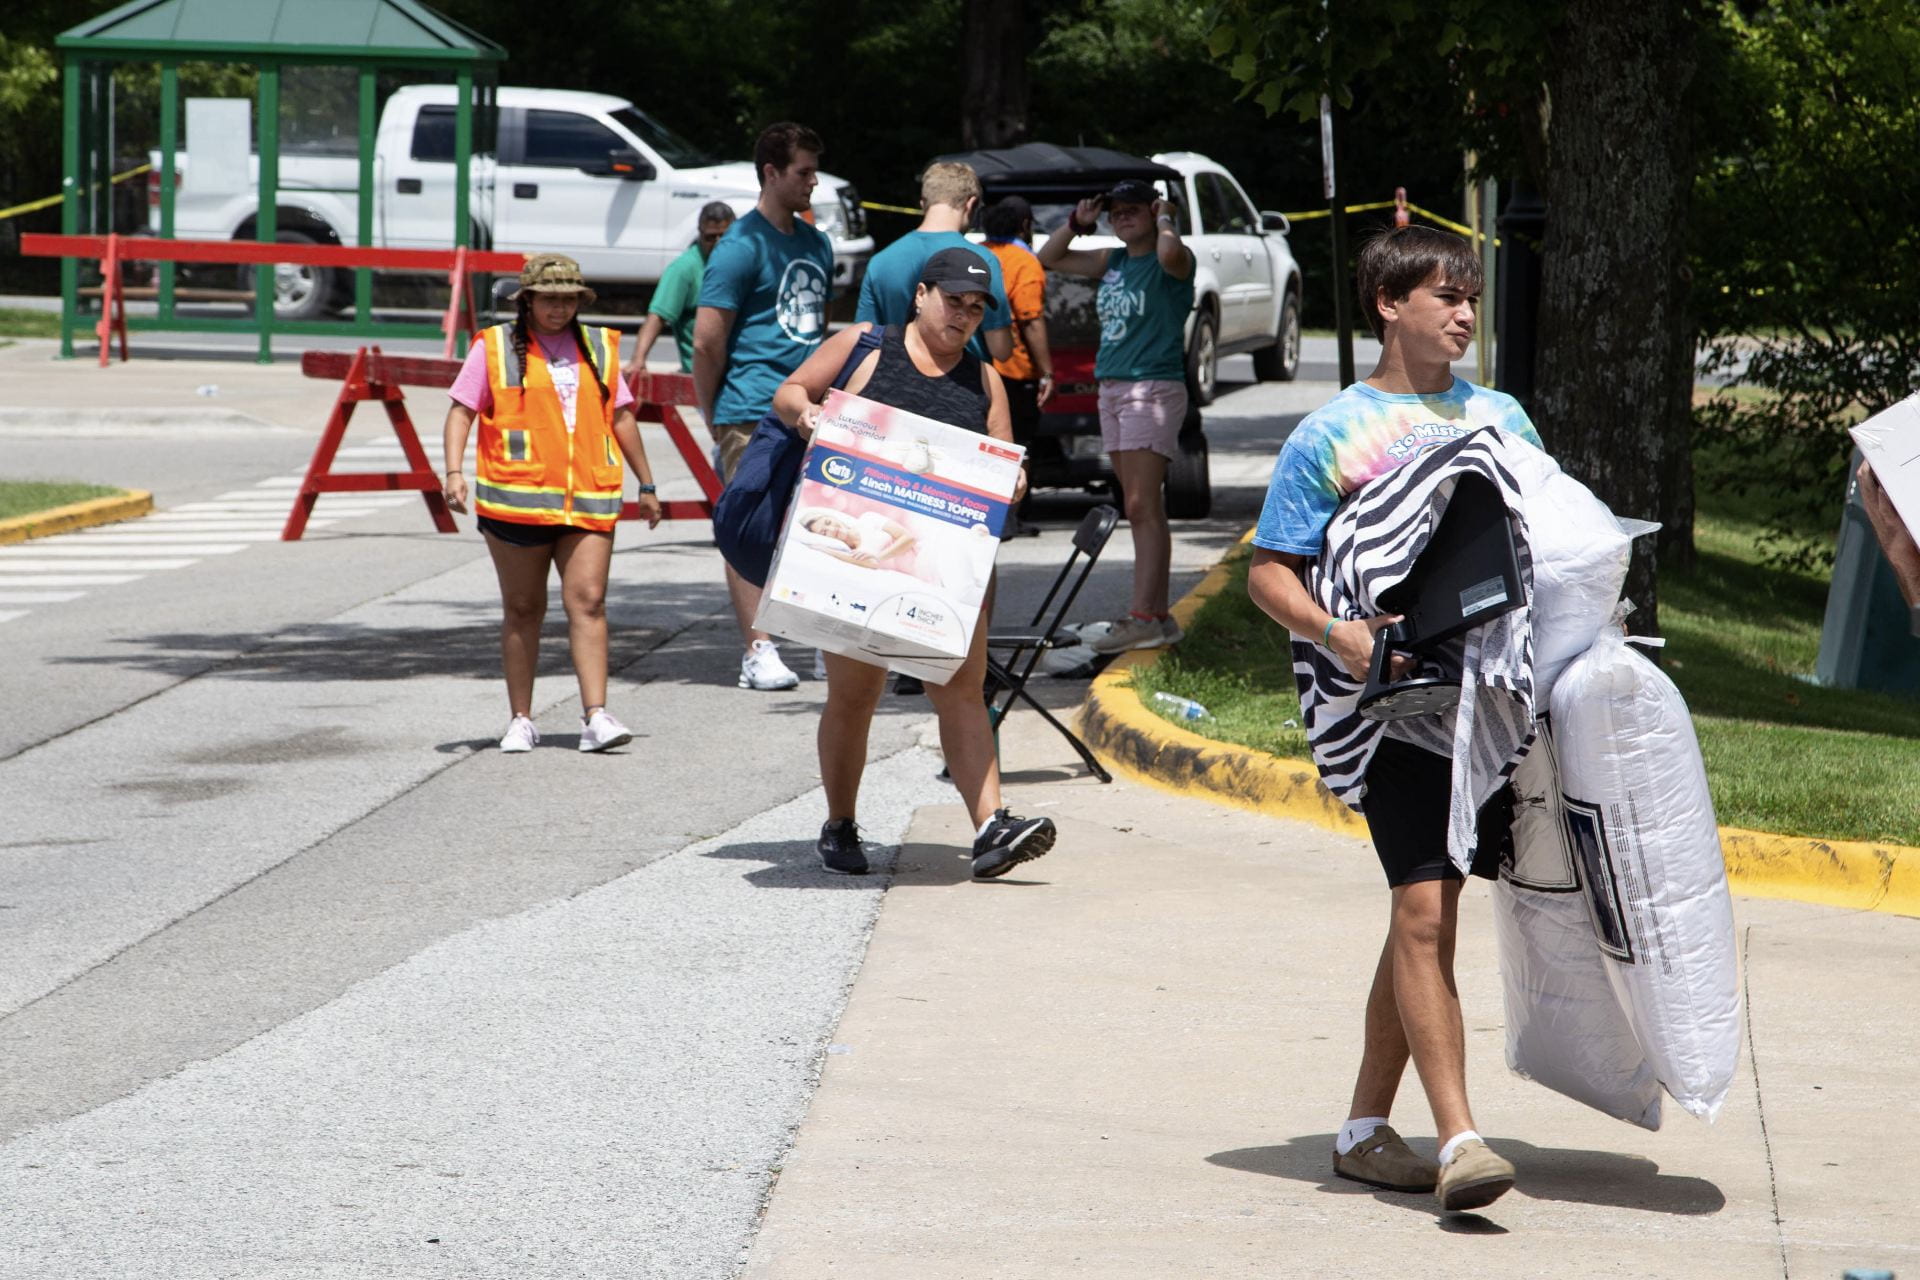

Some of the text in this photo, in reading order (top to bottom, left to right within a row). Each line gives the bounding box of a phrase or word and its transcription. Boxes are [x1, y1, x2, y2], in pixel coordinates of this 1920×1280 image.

[850, 425, 886, 441] Comfort
[1388, 434, 1416, 459] No
[828, 460, 851, 479] Serta
[893, 485, 945, 509] MATTRESS
[947, 502, 987, 523] TOPPER
[961, 497, 990, 513] Foam
[906, 606, 916, 618] 4
